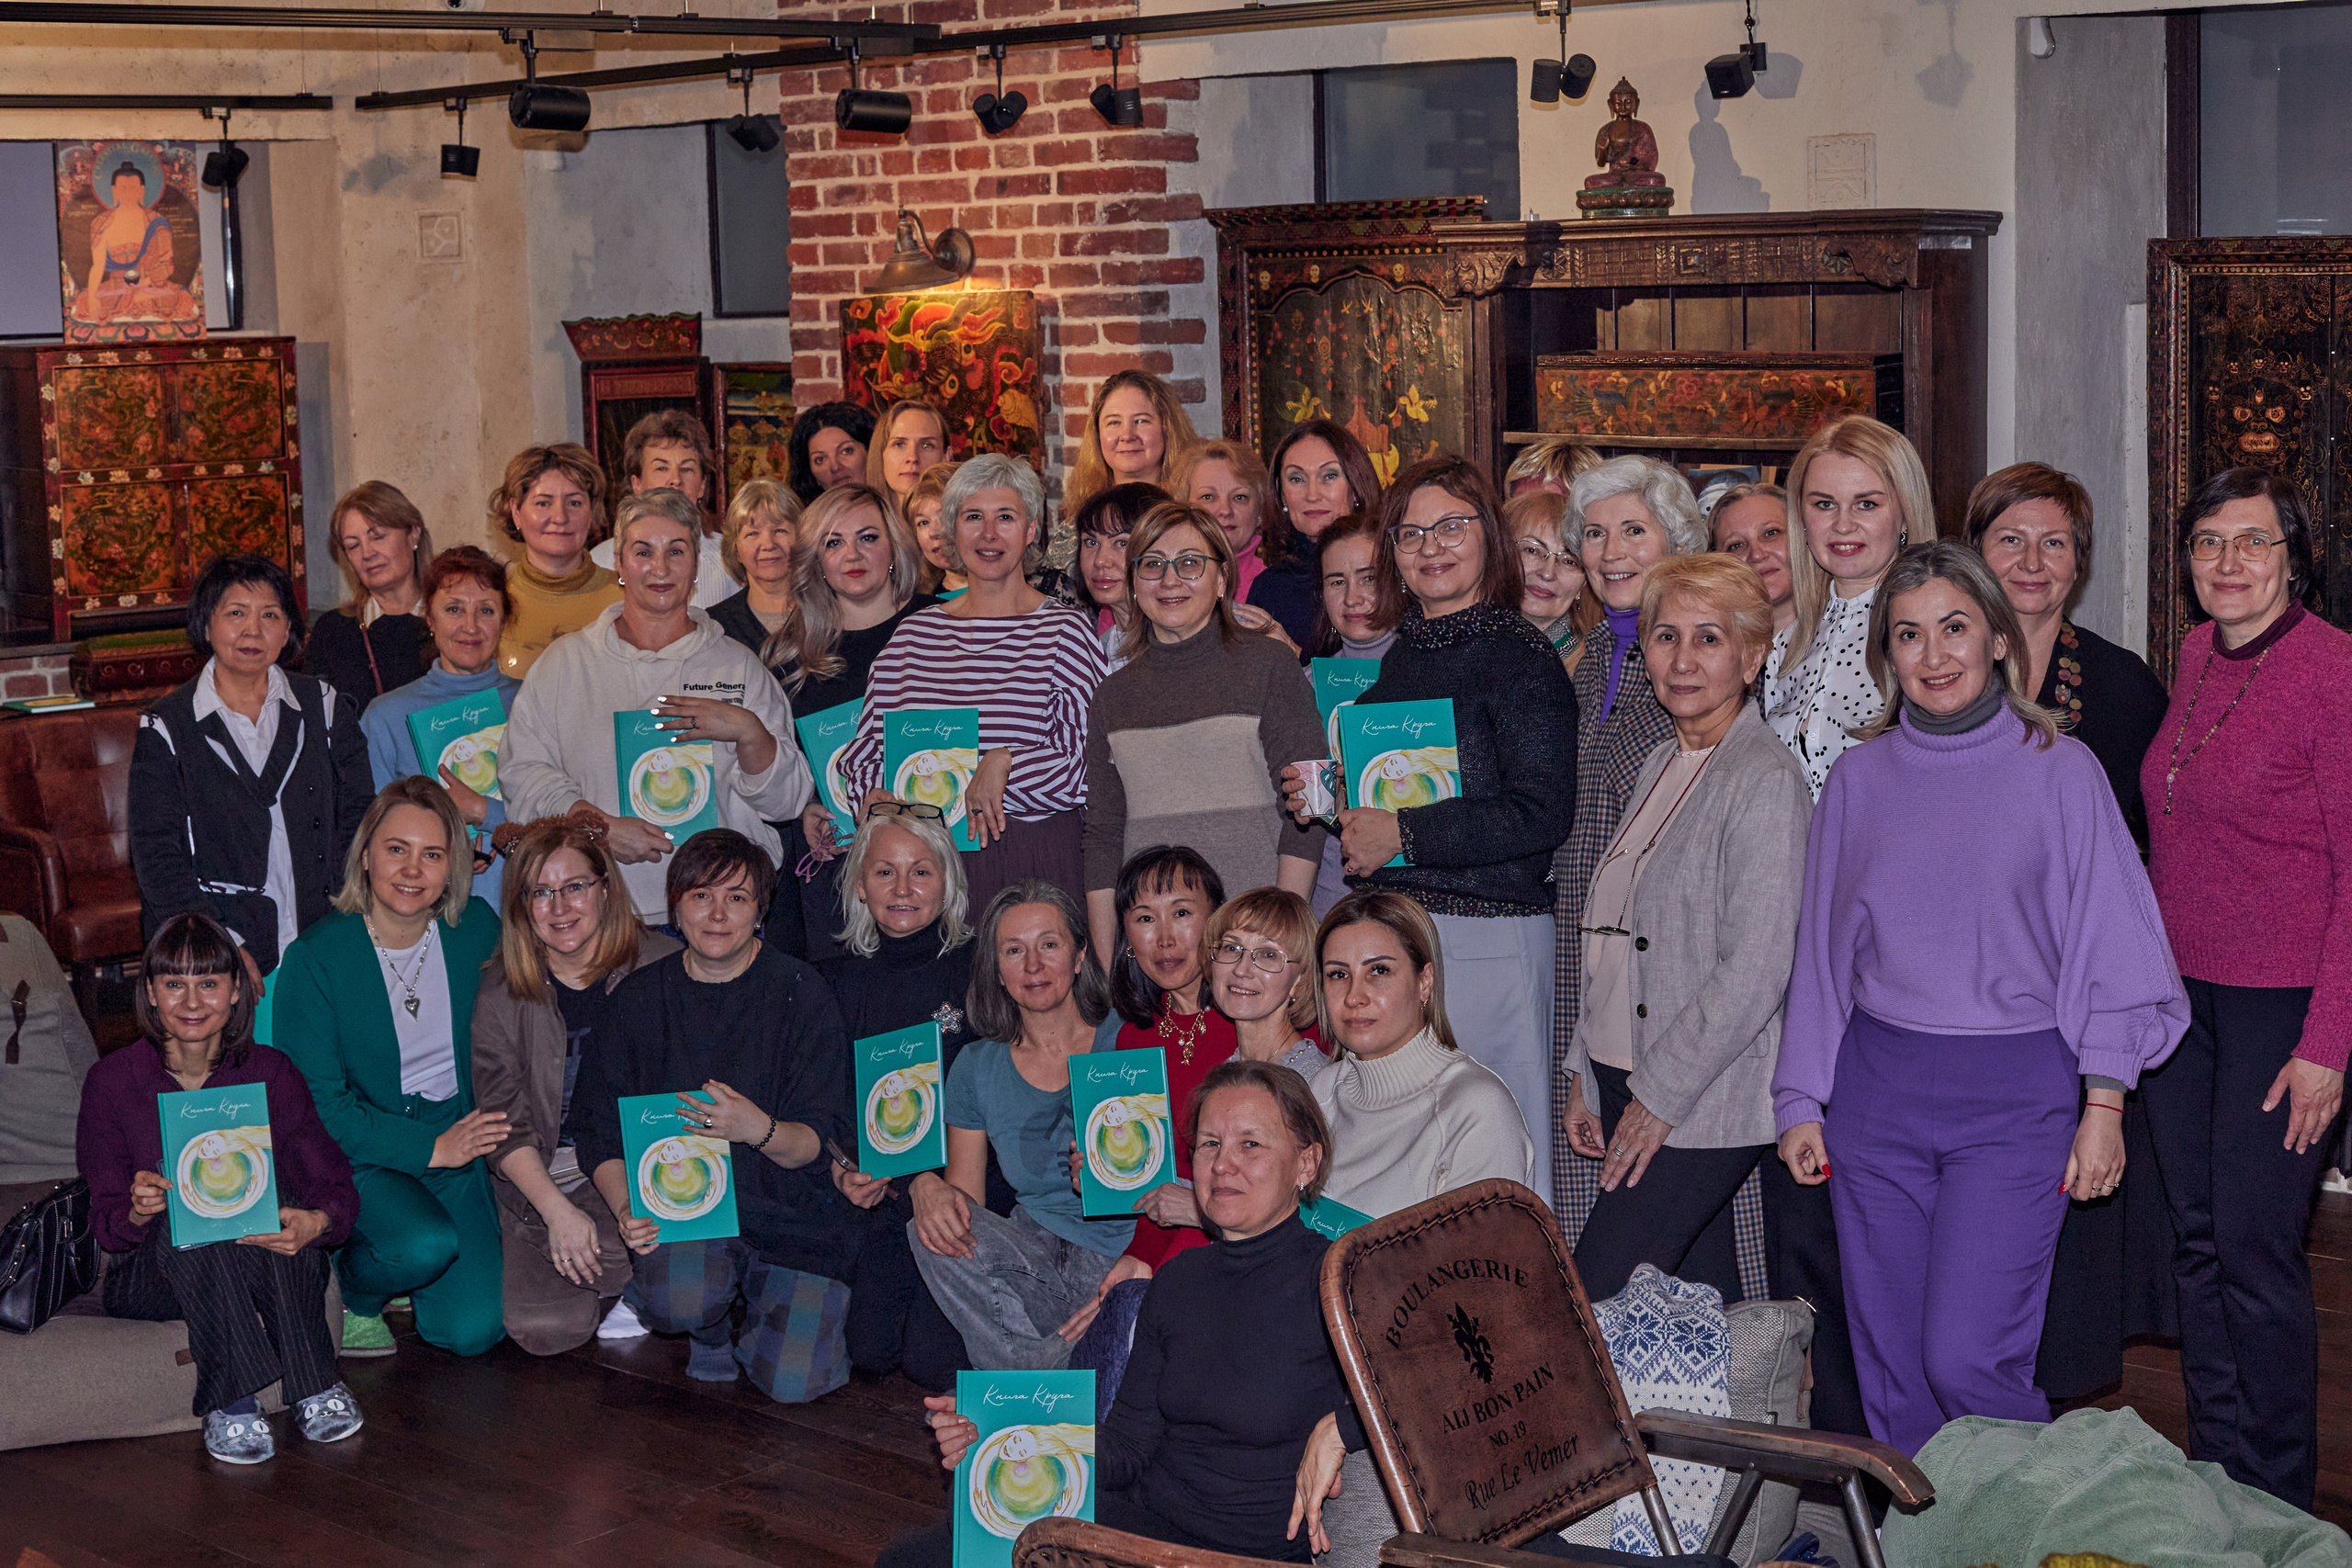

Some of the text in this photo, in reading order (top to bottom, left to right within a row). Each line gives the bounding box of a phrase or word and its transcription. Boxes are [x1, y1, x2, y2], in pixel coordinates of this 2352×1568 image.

[901, 719, 963, 741] Книга Круга
[1362, 714, 1436, 739] Книга Круга
[869, 1038, 924, 1061] Книга Круга
[1087, 1061, 1148, 1086] Книга Круга
[180, 1097, 252, 1121] Книга Круга
[640, 1107, 675, 1124] Книга
[1310, 1210, 1335, 1232] Книга
[1385, 1258, 1529, 1350] BOULANGERIE
[983, 1382, 1074, 1414] Книга Круга
[1472, 1390, 1513, 1423] BON
[1513, 1361, 1555, 1404] PAIN
[1488, 1420, 1527, 1450] NO. 19
[1464, 1478, 1498, 1511] Rue
[1501, 1462, 1522, 1492] Le
